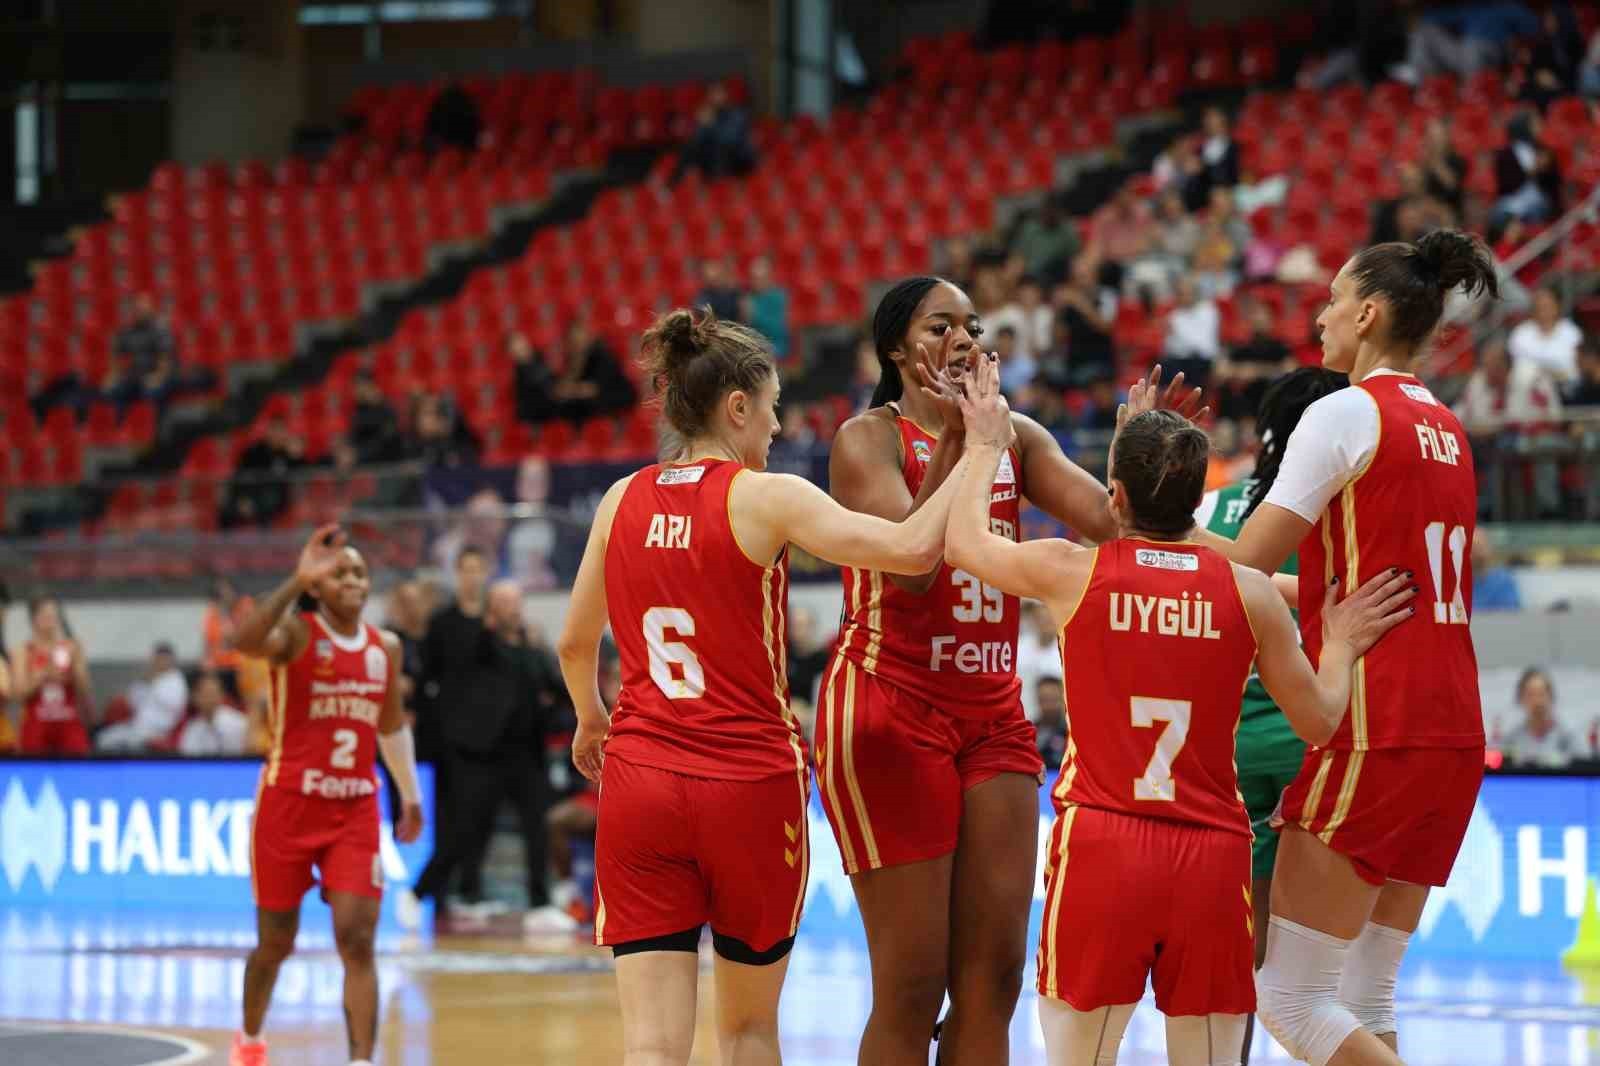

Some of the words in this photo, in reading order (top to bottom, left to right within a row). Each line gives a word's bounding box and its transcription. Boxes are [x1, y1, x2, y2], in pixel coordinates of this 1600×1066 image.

[645, 513, 692, 549] ARI
[951, 568, 1005, 624] 35
[1424, 521, 1469, 625] 11
[1108, 590, 1221, 640] UYGÜL
[643, 606, 705, 700] 6
[929, 635, 1012, 674] Ferre
[330, 728, 359, 770] 2
[1130, 696, 1192, 802] 7
